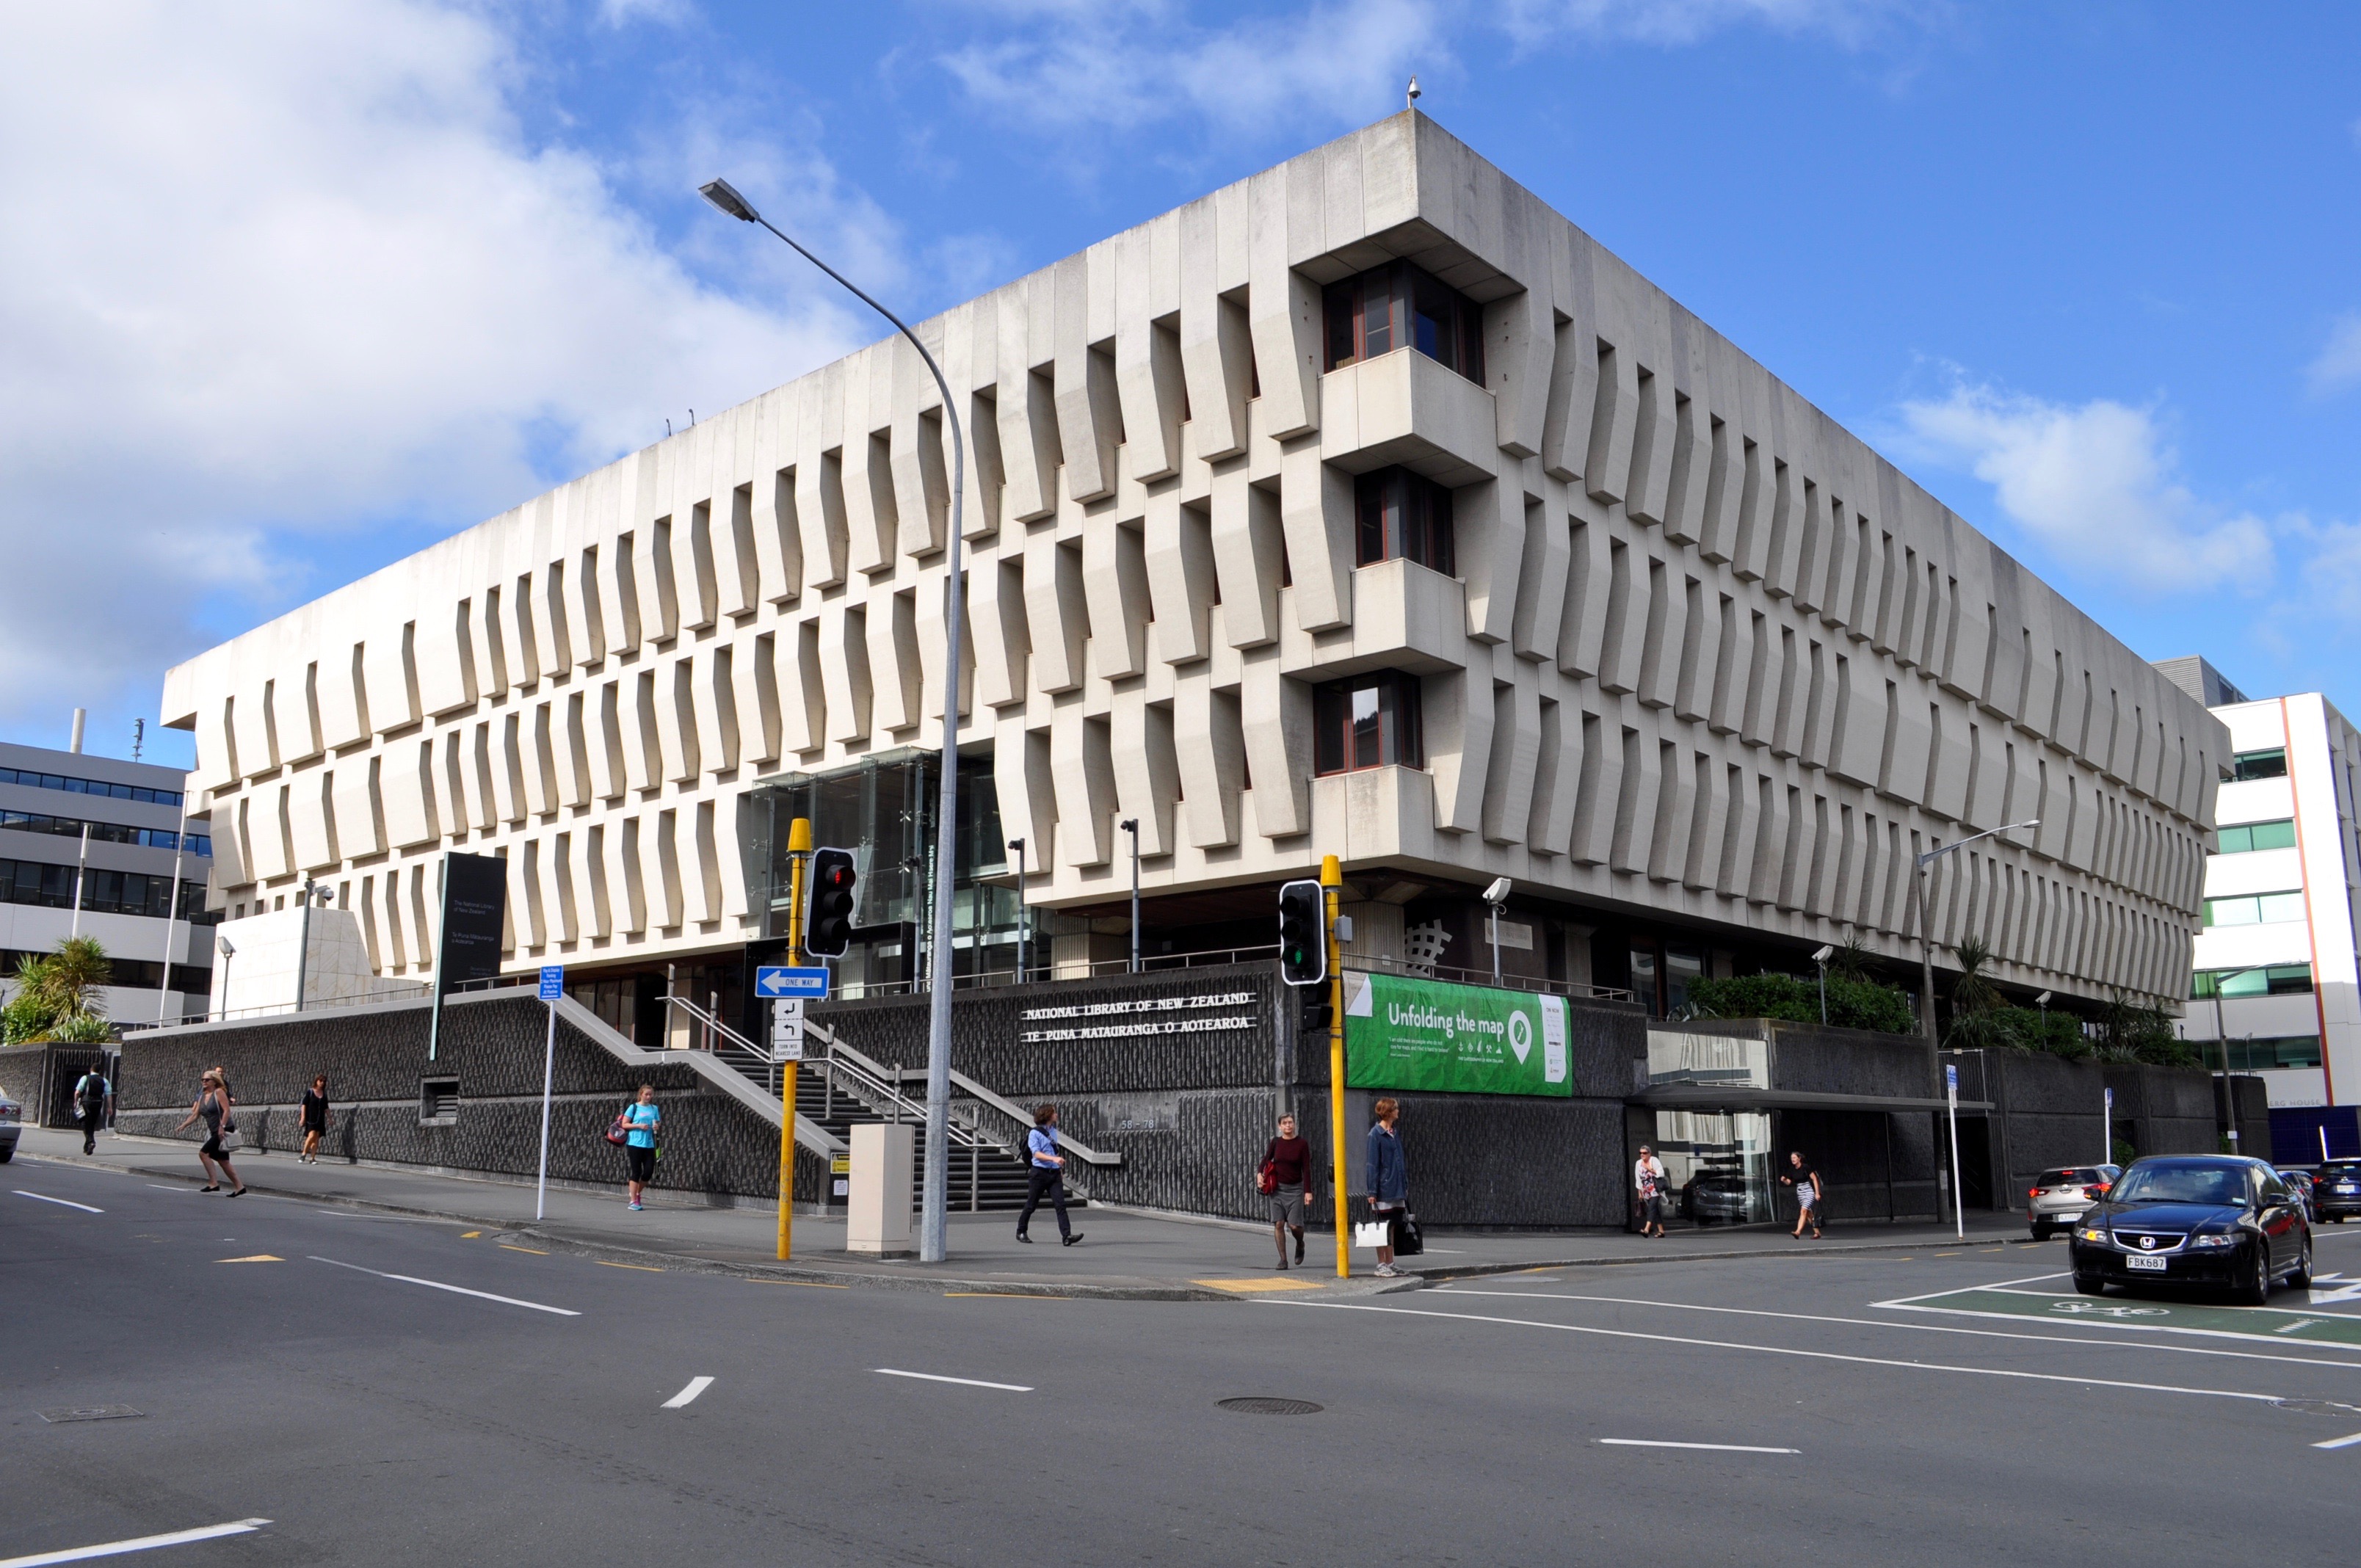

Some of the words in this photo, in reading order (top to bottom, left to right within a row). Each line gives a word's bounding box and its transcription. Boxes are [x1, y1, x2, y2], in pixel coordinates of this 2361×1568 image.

[1026, 1006, 1078, 1020] NATIONAL
[1084, 1001, 1131, 1017] LIBRARY
[1136, 1000, 1152, 1012] OF
[1158, 997, 1184, 1011] NEW
[1190, 992, 1249, 1008] ZEALAND
[1026, 1031, 1040, 1042] TE
[1046, 1028, 1076, 1041] PUNA
[1081, 1023, 1158, 1039] MATAURANGA
[1164, 1021, 1175, 1033] O
[1180, 1017, 1249, 1032] AOTEAROA
[1388, 1002, 1454, 1039] Unfolding
[1456, 1009, 1476, 1032] the
[1478, 1020, 1504, 1042] map
[1122, 1120, 1132, 1129] 58
[1144, 1119, 1154, 1128] 78
[2128, 1257, 2164, 1268] FBK687
